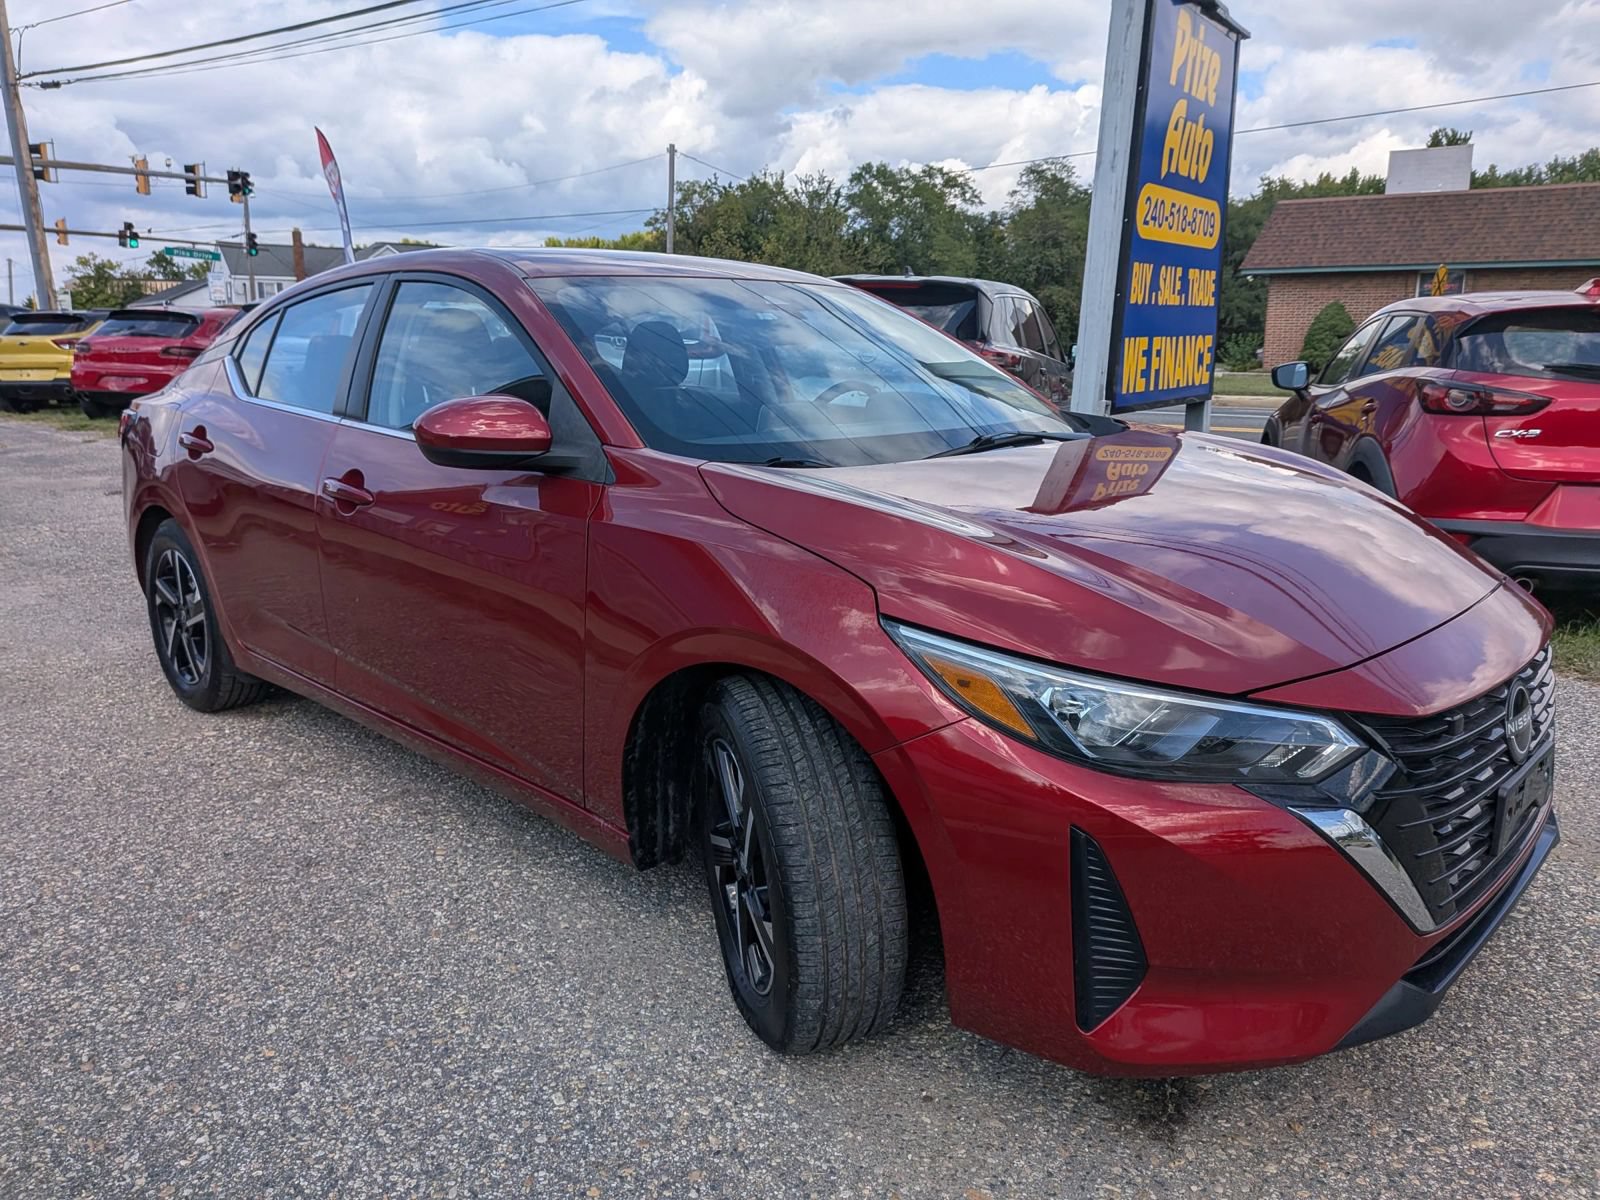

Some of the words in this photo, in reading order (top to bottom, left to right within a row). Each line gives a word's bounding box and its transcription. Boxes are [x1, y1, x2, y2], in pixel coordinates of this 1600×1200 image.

[1170, 7, 1221, 108] Prize
[1161, 98, 1214, 183] Auto
[1143, 195, 1216, 238] 240-518-8709
[1187, 268, 1217, 307] TRADE
[1121, 336, 1149, 395] WE
[1149, 335, 1213, 391] FINANCE
[1507, 713, 1532, 735] NISS
